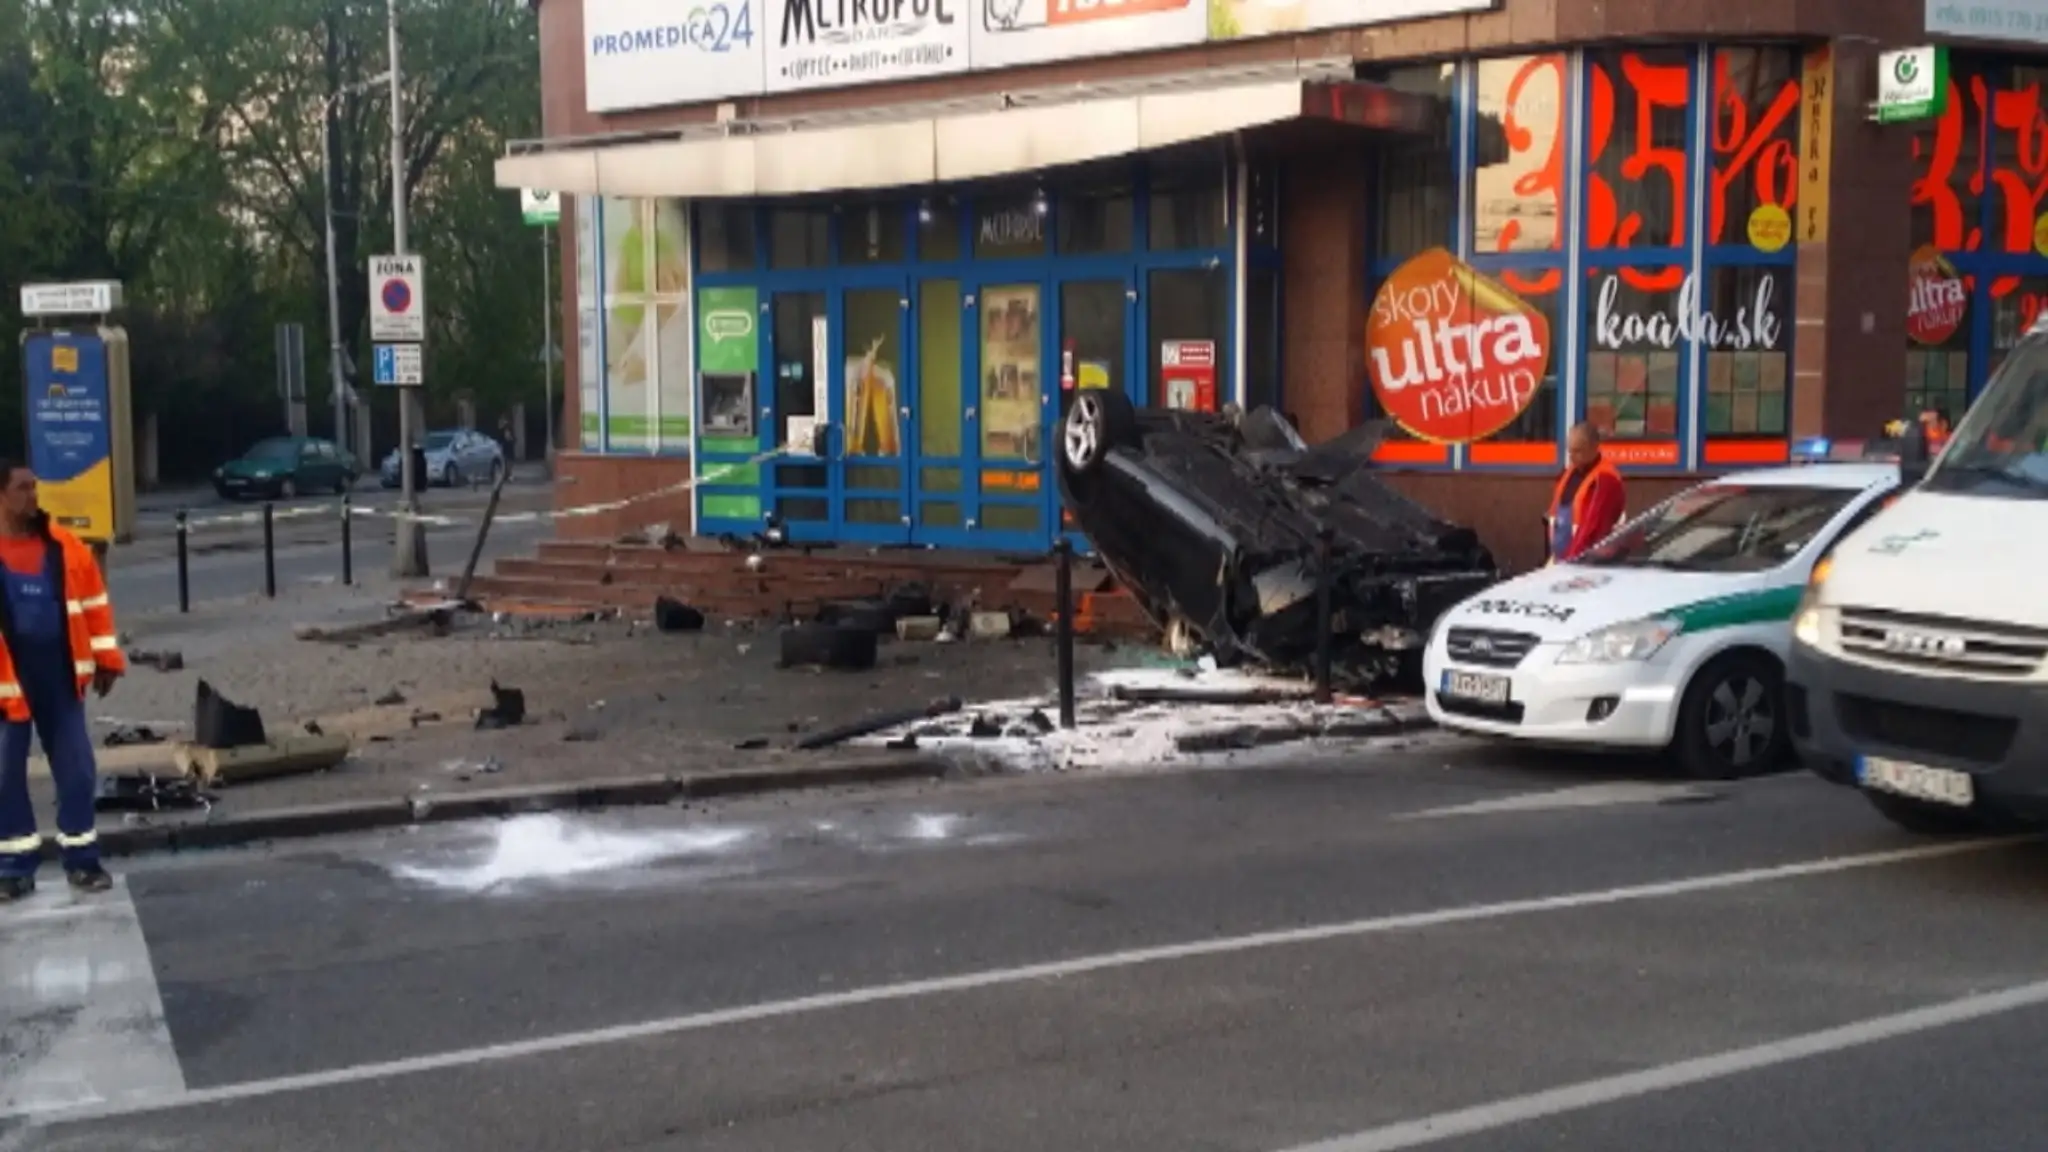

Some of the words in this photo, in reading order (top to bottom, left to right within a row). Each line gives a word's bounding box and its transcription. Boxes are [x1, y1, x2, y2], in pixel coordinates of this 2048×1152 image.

[1597, 272, 1781, 349] koala.sk
[1371, 313, 1541, 392] ultra
[1420, 367, 1535, 421] nákup
